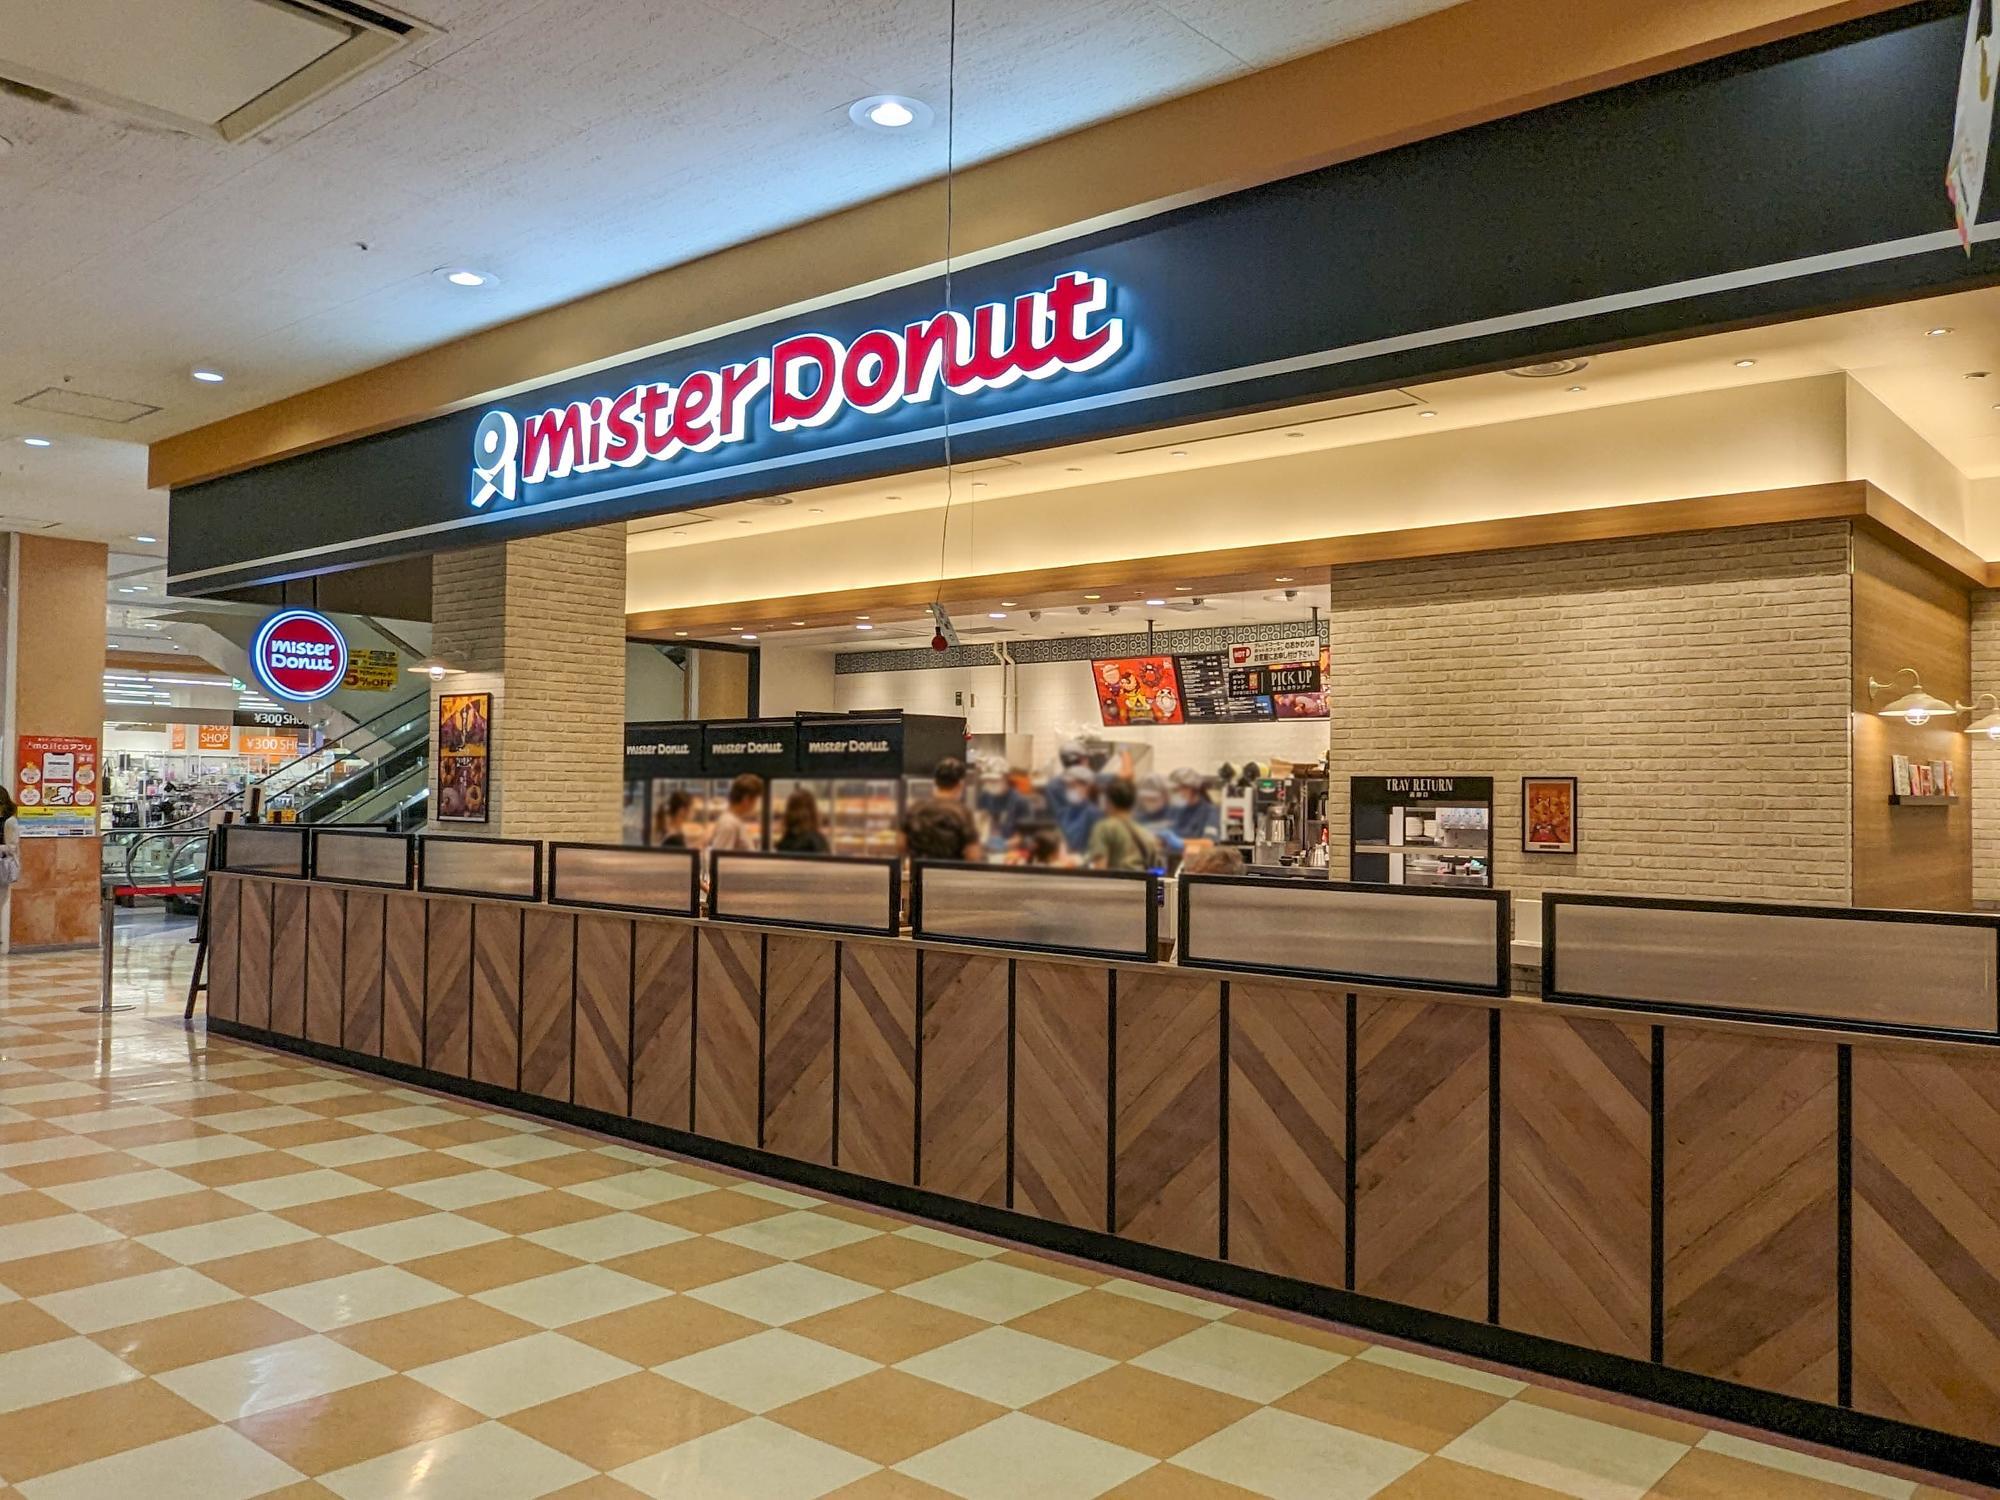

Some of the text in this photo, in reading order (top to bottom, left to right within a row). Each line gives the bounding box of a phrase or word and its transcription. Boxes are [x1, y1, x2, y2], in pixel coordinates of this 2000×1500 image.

[770, 271, 1122, 432] Donut
[271, 653, 335, 671] Donut
[1271, 669, 1313, 686] PICK UP
[254, 713, 282, 725] ¥300
[201, 734, 228, 743] SHOP
[247, 738, 278, 750] ¥300
[658, 743, 690, 755] Donut
[748, 742, 783, 753] Donut
[850, 740, 890, 752] Donut
[1386, 778, 1454, 792] TRAY RETURN
